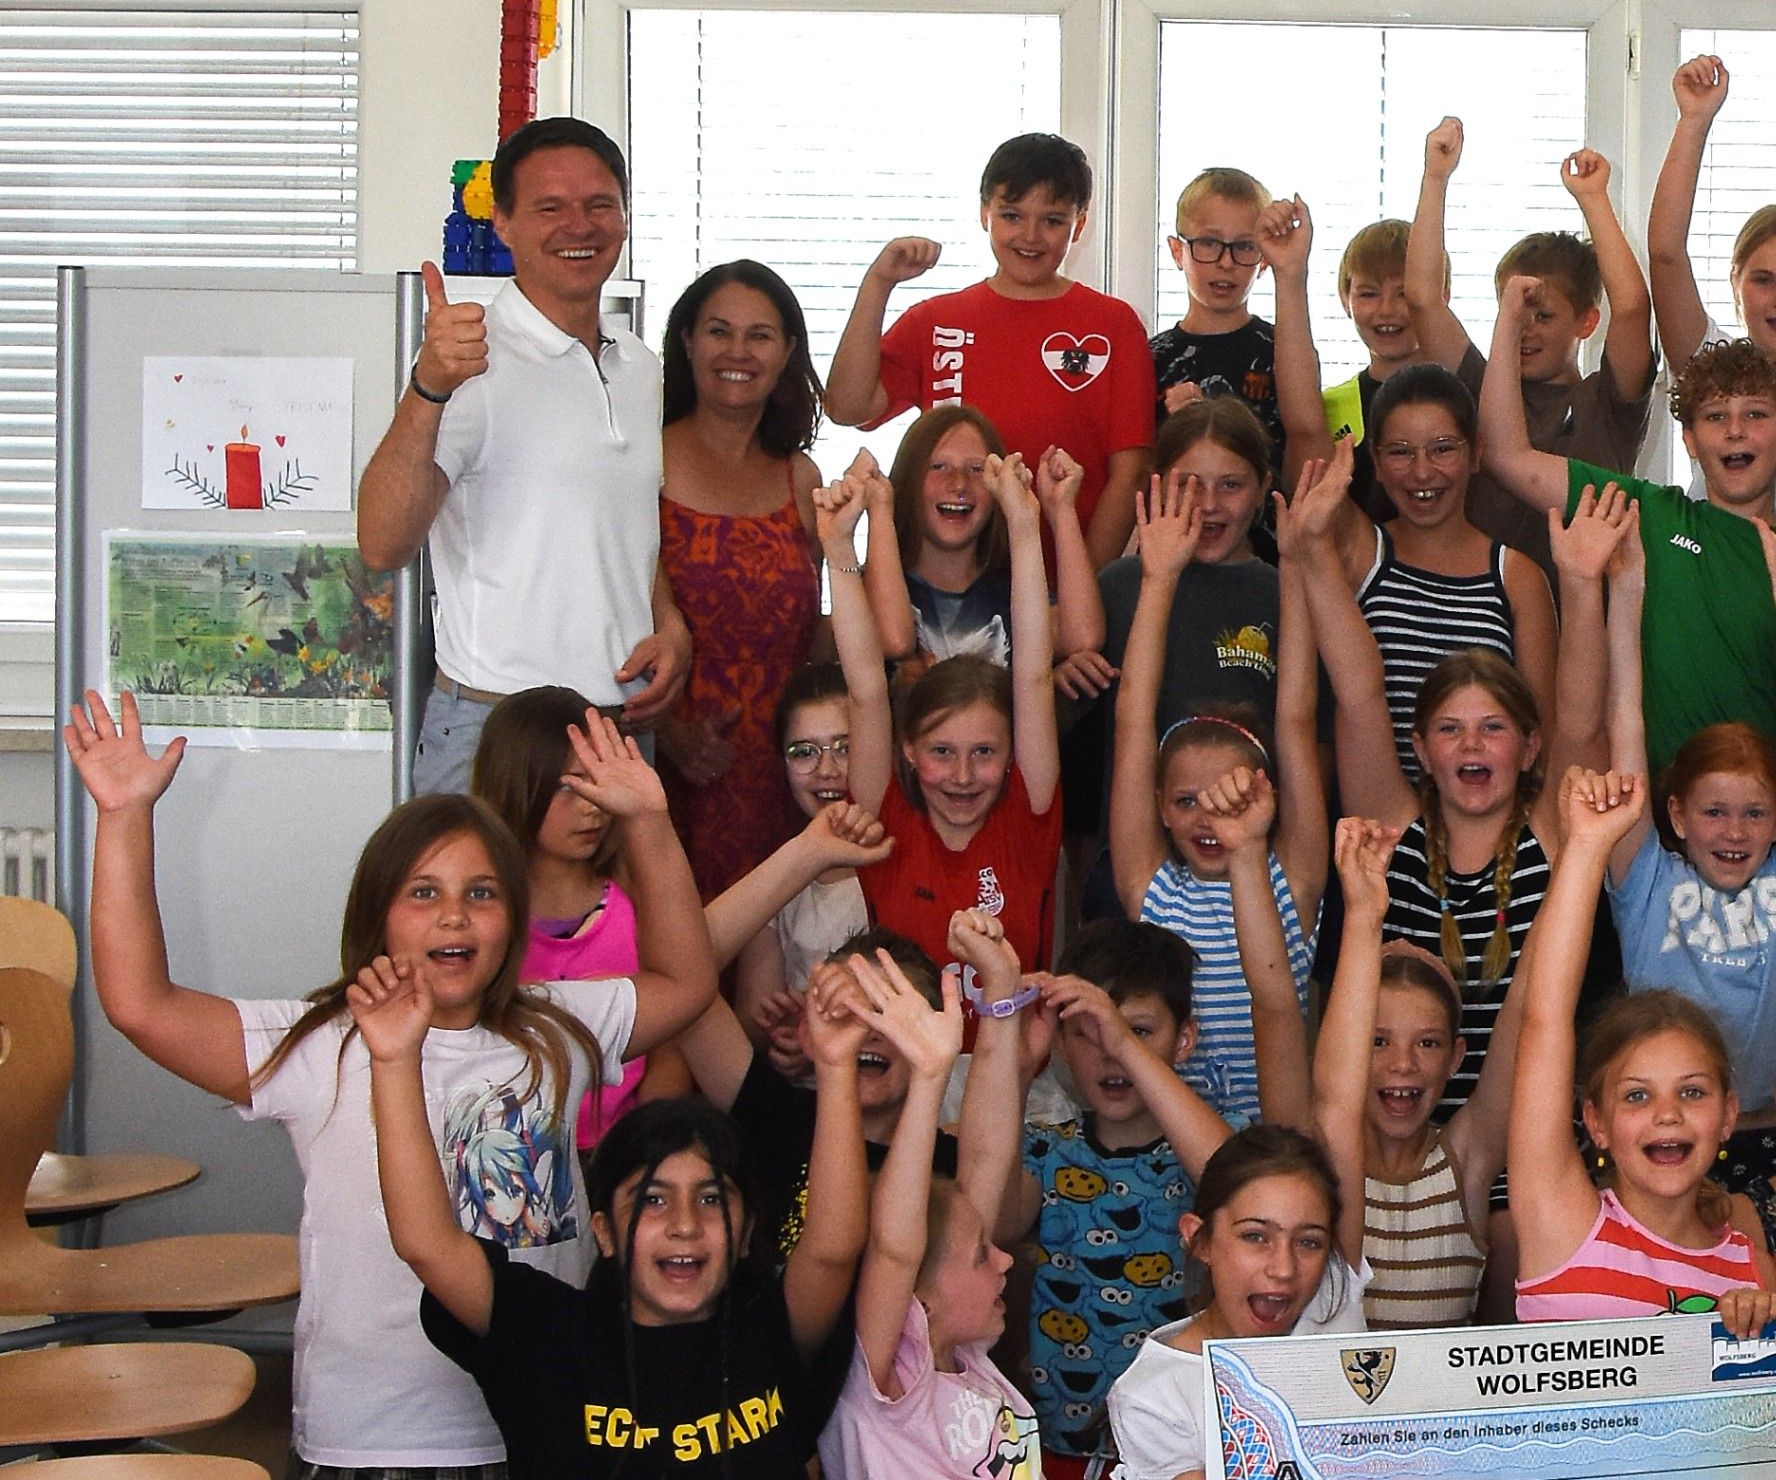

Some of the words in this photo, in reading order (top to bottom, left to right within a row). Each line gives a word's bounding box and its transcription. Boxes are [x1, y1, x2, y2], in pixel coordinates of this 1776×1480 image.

[932, 325, 975, 408] ÖST
[1669, 533, 1702, 554] JAKO
[1219, 658, 1253, 669] Beach
[1448, 1335, 1665, 1367] STADTGEMEINDE
[1477, 1366, 1637, 1396] WOLFSBERG
[672, 1386, 785, 1462] STARK
[1340, 1432, 1390, 1446] Zahlen
[1394, 1429, 1416, 1443] Sie
[1421, 1429, 1439, 1441] an
[1443, 1426, 1470, 1439] den
[1474, 1421, 1528, 1437] Inhaber
[1532, 1418, 1577, 1434] dieses
[1581, 1415, 1639, 1430] Schecks
